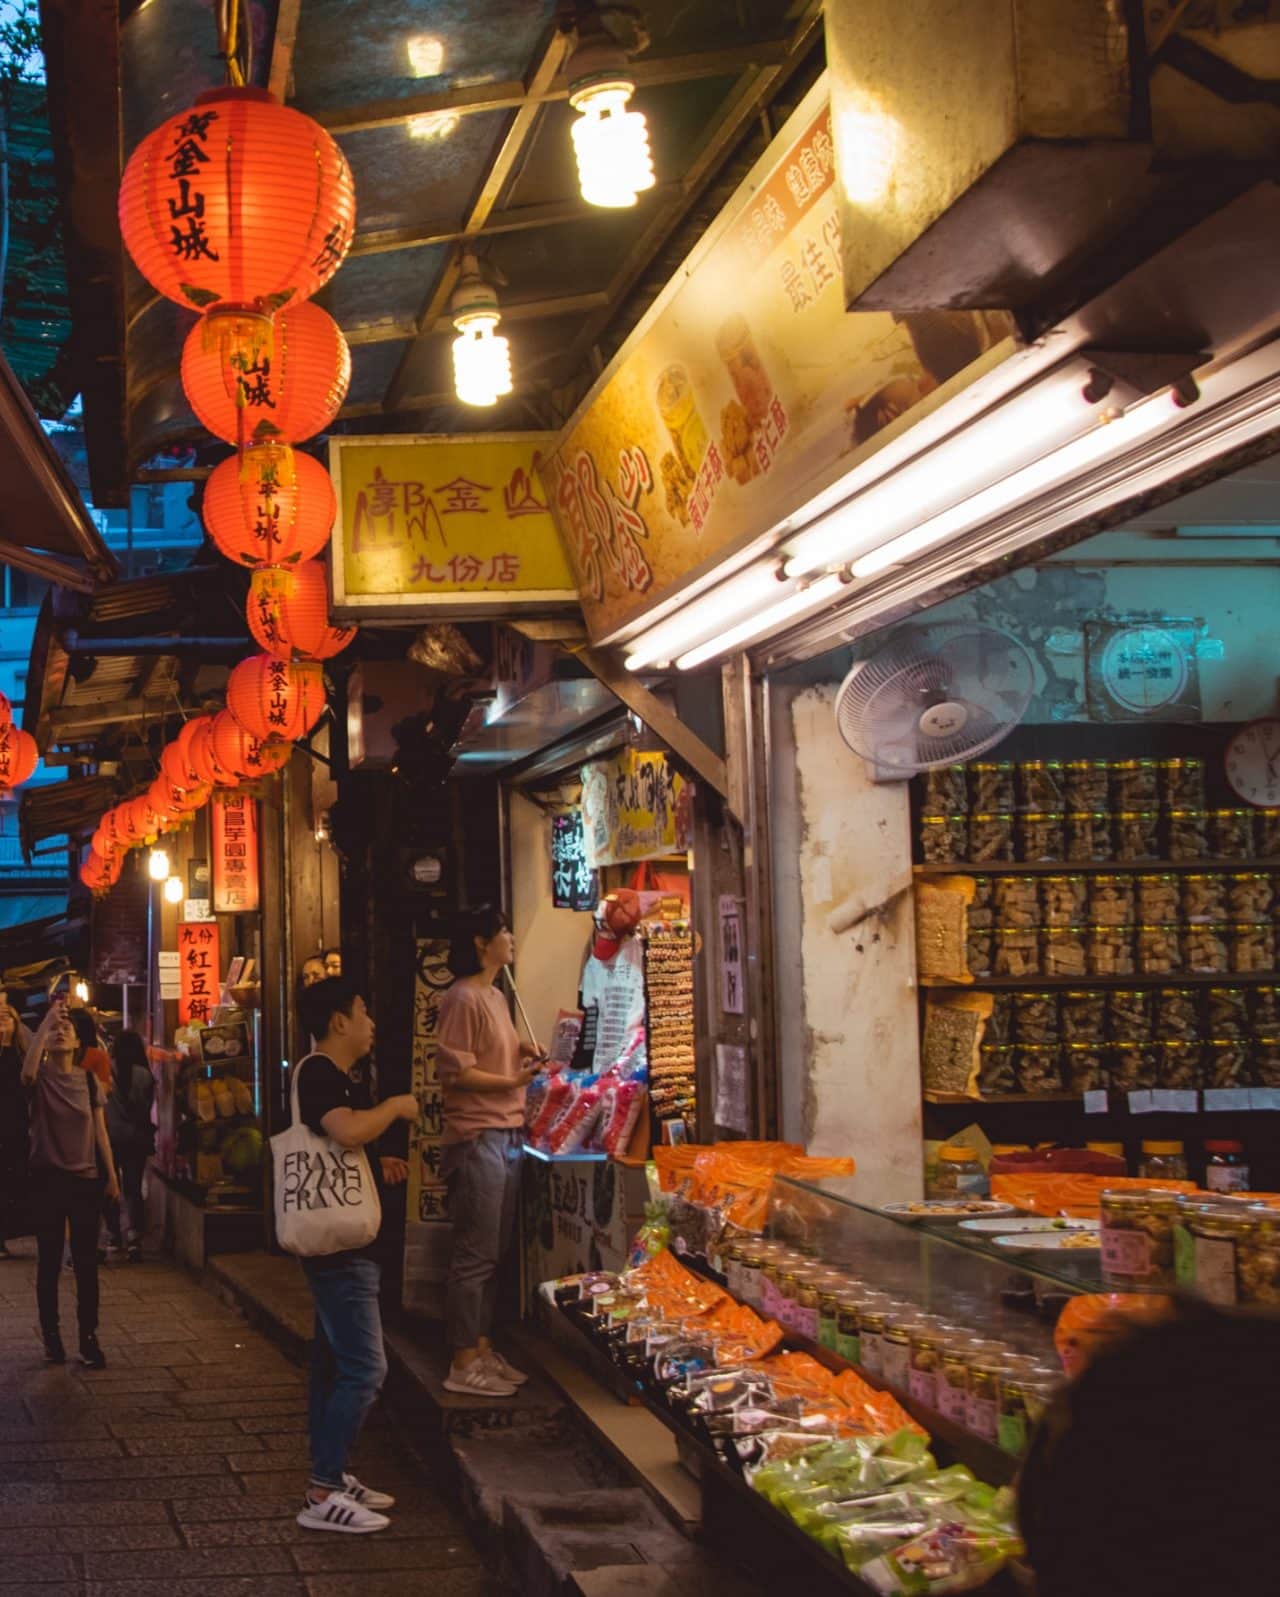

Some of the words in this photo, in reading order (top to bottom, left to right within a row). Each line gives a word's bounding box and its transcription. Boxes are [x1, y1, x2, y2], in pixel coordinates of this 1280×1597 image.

[409, 553, 520, 584] 九份店
[182, 927, 214, 945] 九份
[187, 949, 212, 1022] 紅豆餅
